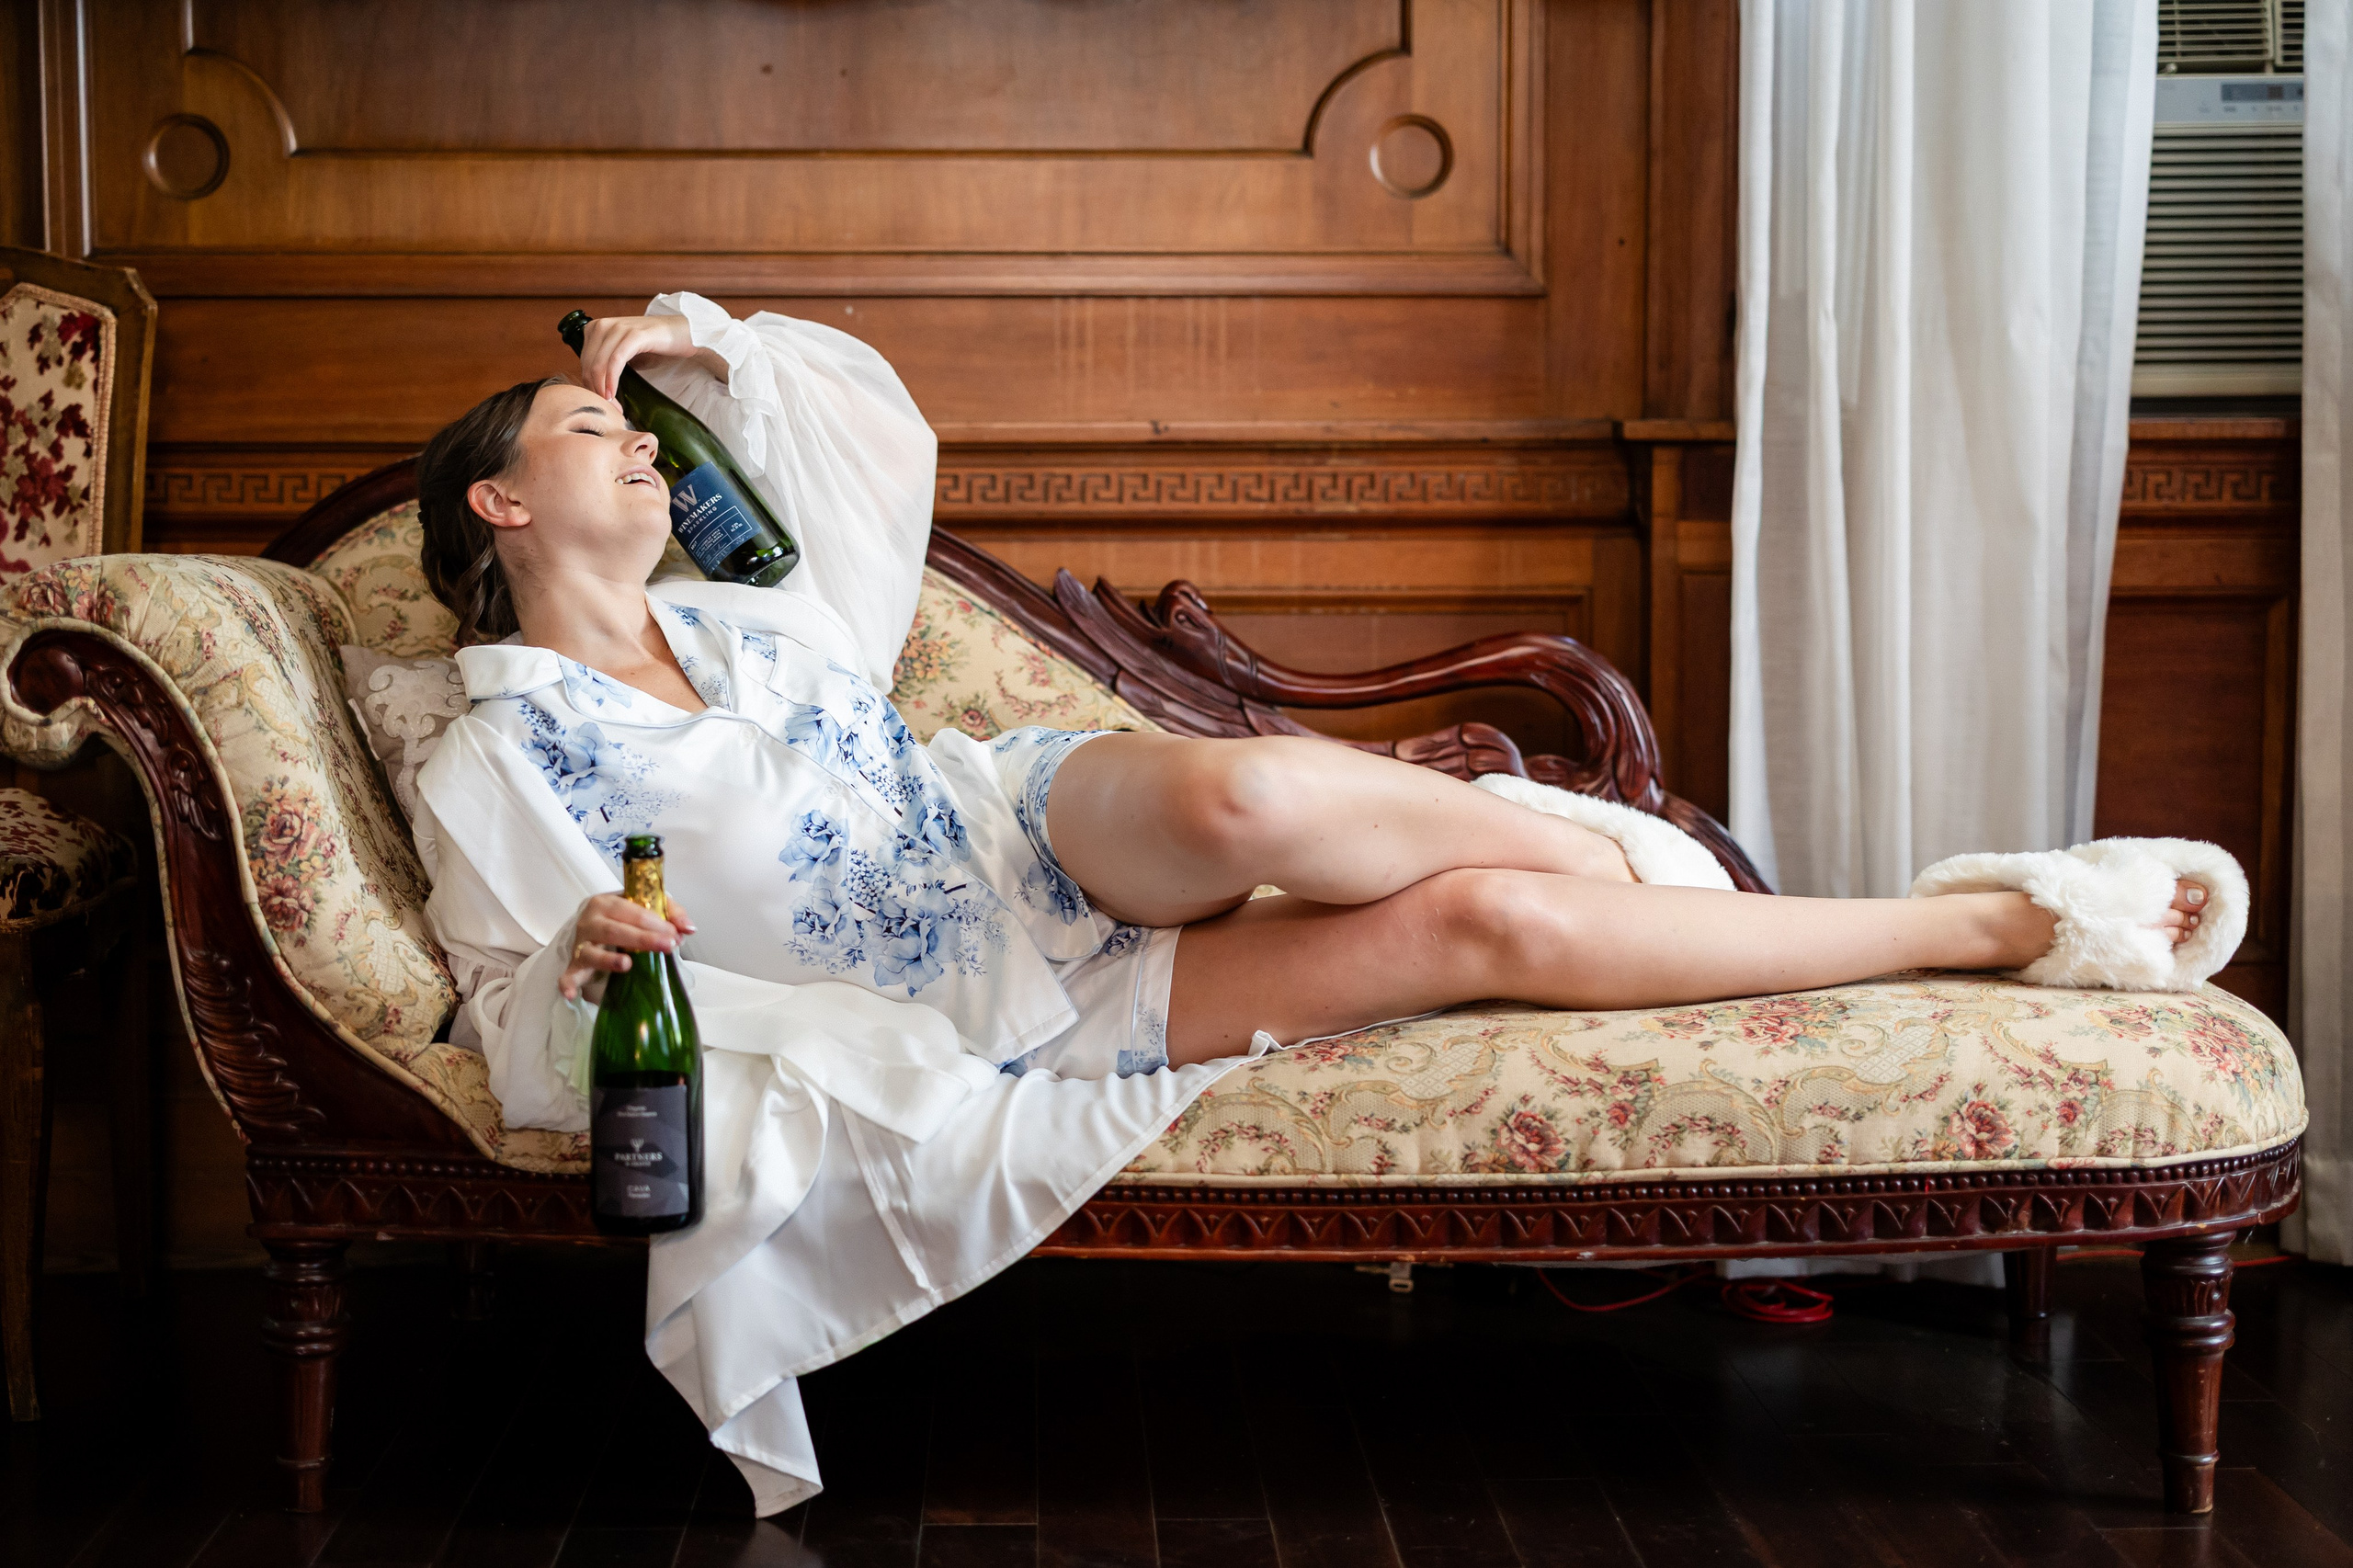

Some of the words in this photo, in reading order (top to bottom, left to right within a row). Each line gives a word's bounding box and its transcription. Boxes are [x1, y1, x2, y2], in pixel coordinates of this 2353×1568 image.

[672, 484, 698, 513] W
[678, 493, 722, 533] WINEMAKERS
[687, 506, 717, 534] SPARKLING
[614, 1152, 663, 1162] PARTNERS
